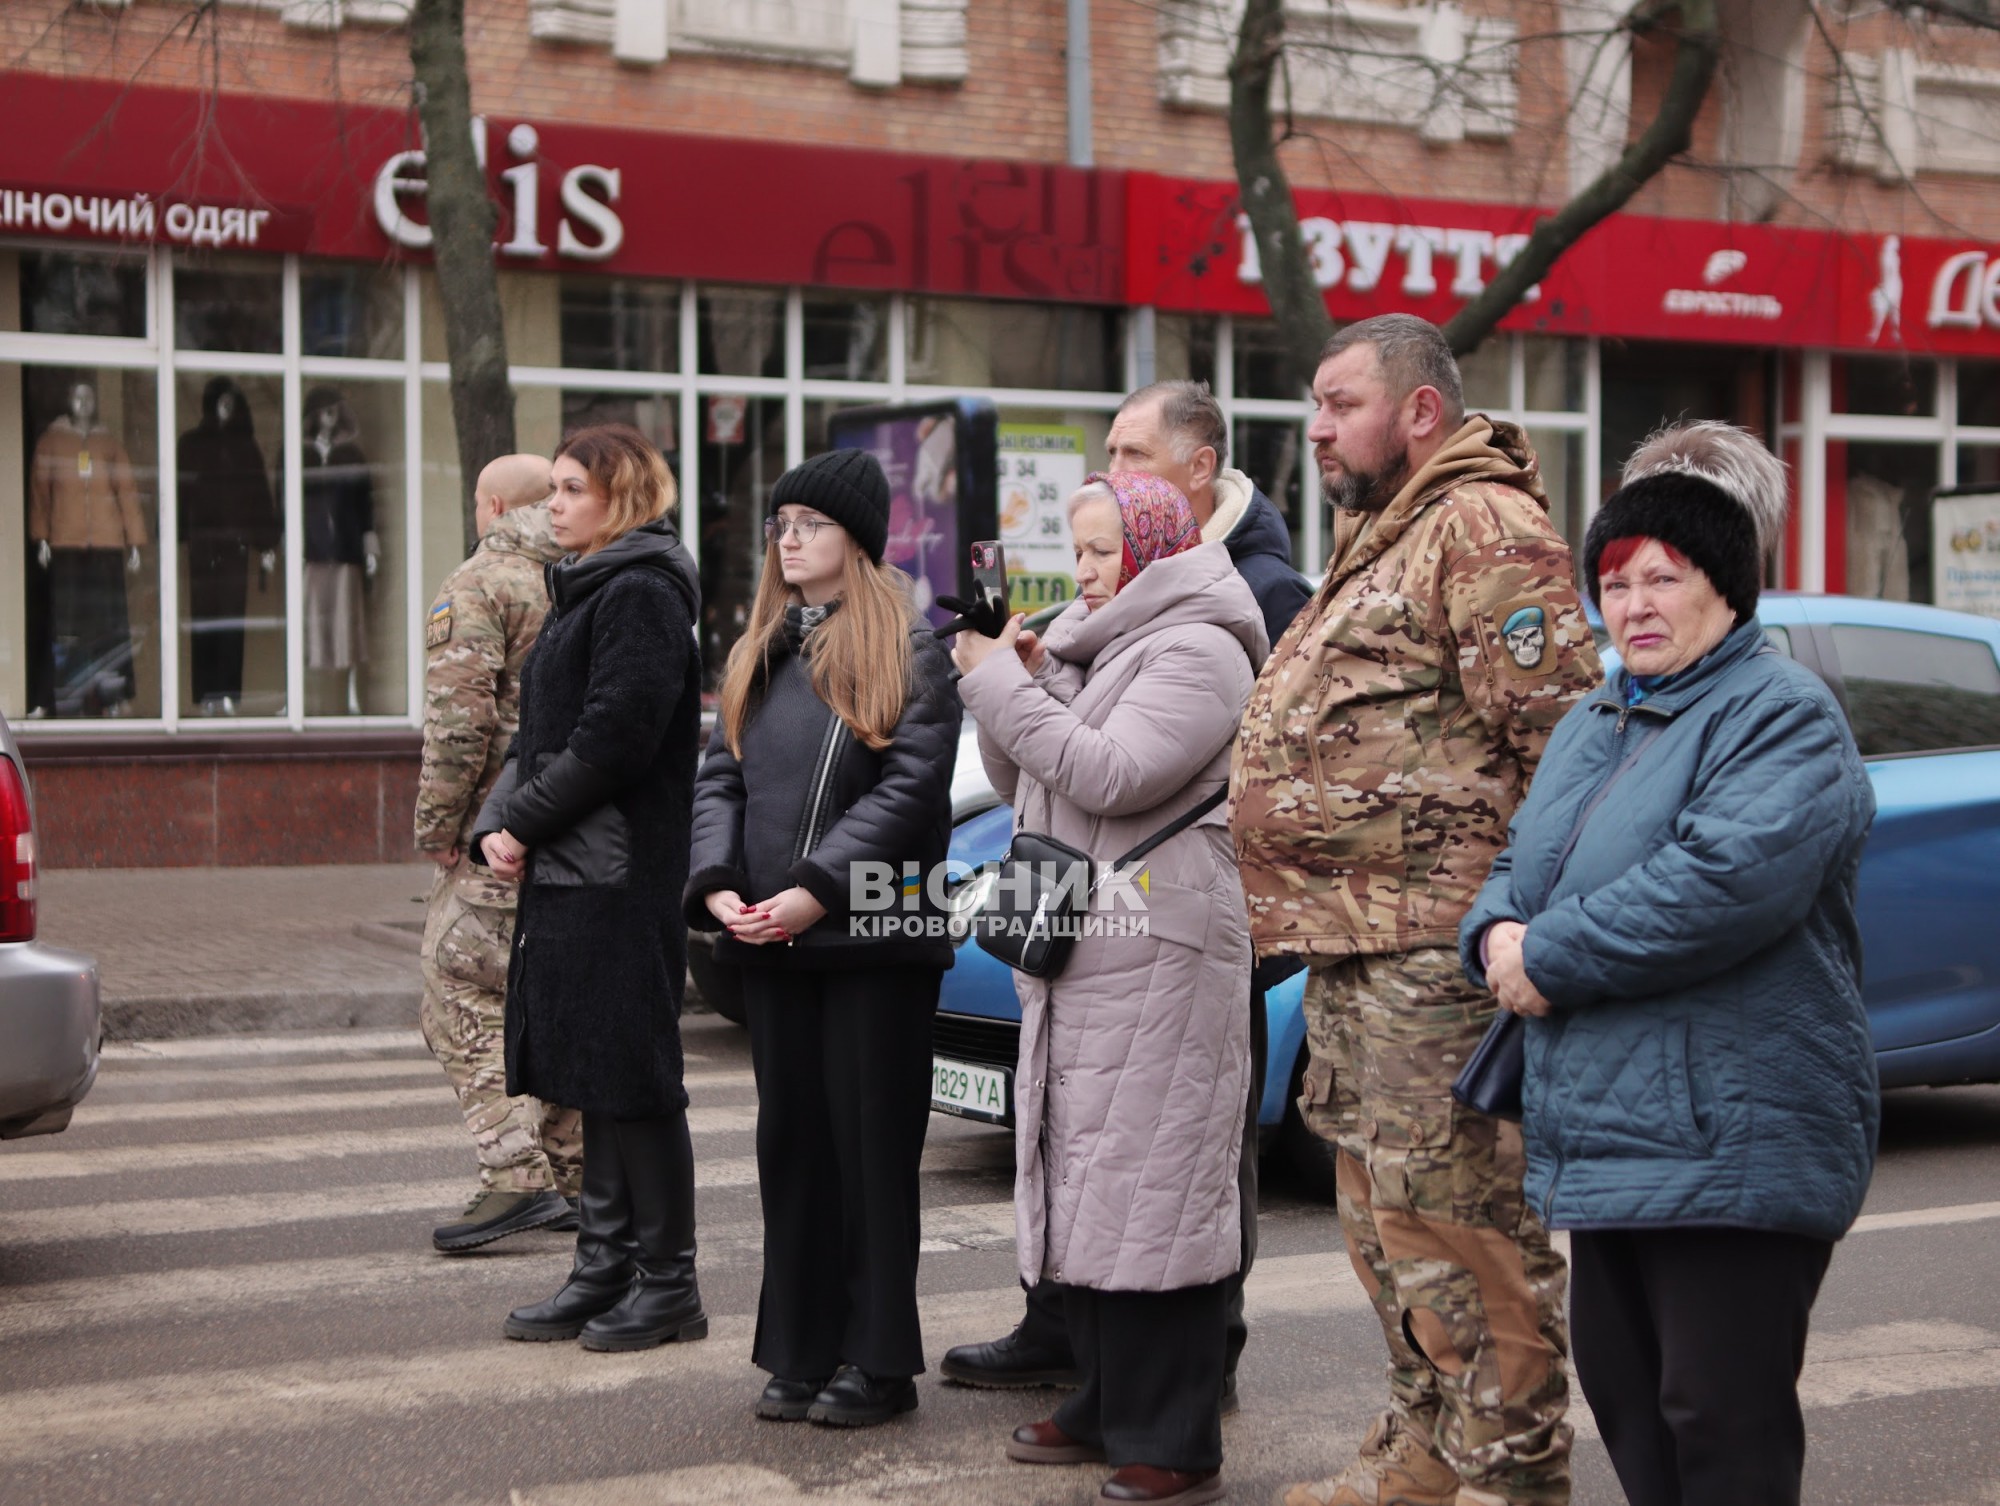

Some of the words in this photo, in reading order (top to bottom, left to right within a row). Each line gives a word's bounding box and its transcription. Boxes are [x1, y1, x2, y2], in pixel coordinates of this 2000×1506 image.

[0, 188, 156, 238] ІНОЧИЙ
[165, 203, 270, 248] ОДЯГ
[1017, 458, 1036, 477] 34
[1038, 482, 1058, 501] 35
[1041, 516, 1061, 535] 36
[933, 1065, 968, 1100] 1829
[974, 1073, 1000, 1108] YA
